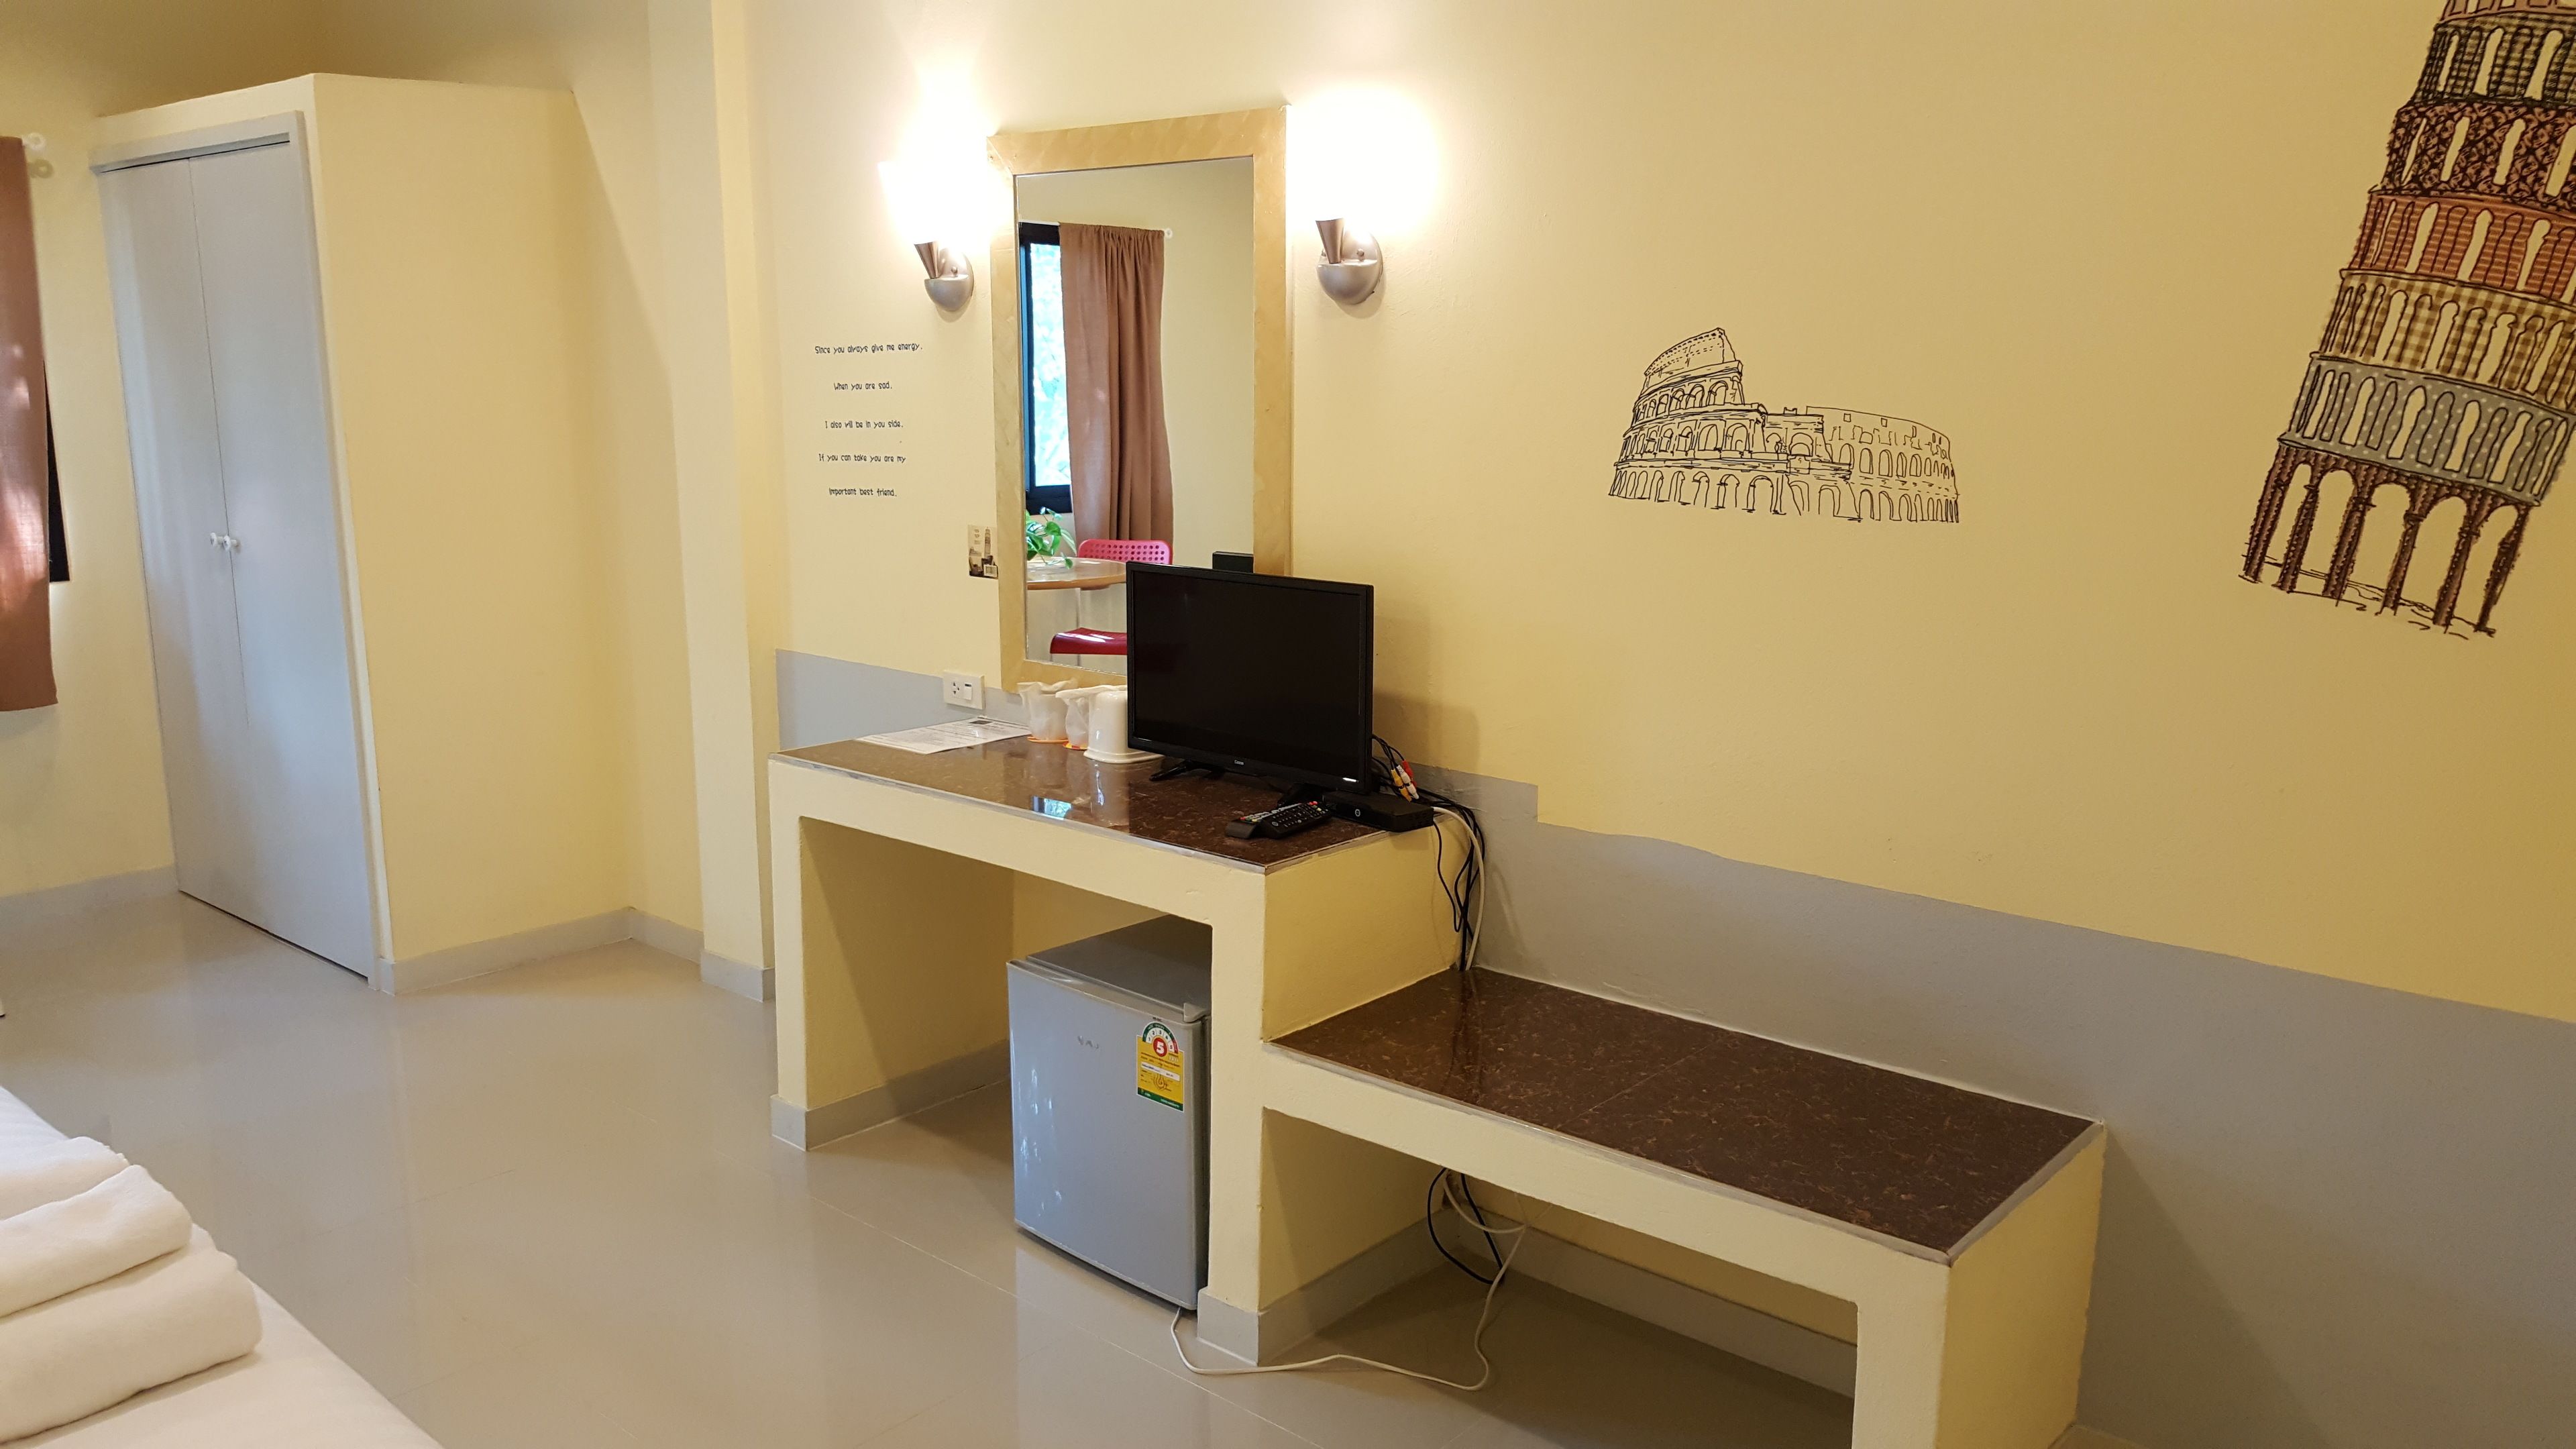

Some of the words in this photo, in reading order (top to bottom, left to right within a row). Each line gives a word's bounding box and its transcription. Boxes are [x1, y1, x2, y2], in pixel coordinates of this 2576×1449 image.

[814, 345, 830, 354] Since
[833, 346, 845, 354] you
[847, 345, 868, 354] always
[871, 343, 883, 354] give
[898, 343, 923, 352] energy.
[833, 382, 848, 390] When
[879, 381, 892, 390] sad.
[825, 421, 828, 429] I
[866, 420, 871, 428] in
[873, 421, 885, 429] you
[888, 420, 904, 428] side.
[818, 453, 824, 462] If
[859, 488, 873, 496] best
[876, 488, 897, 496] friend.
[1156, 1040, 1165, 1054] 5
